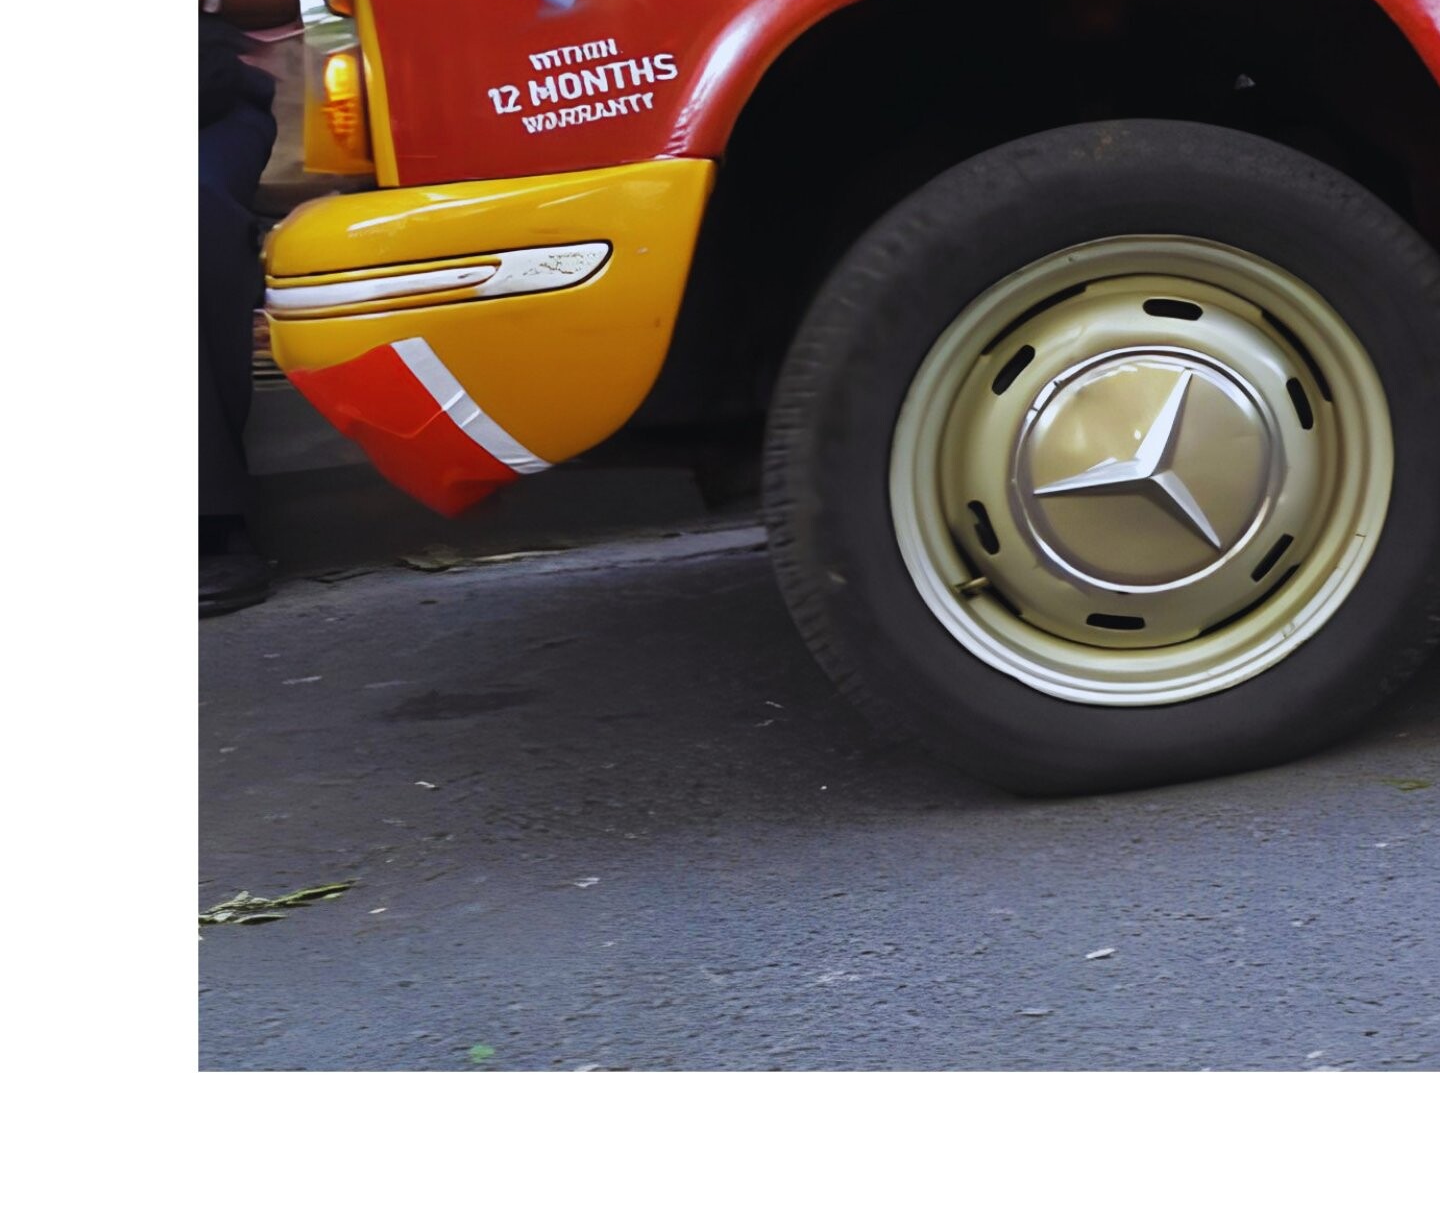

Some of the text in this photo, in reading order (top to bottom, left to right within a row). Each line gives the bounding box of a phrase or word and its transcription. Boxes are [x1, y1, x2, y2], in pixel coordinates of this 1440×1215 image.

[487, 53, 678, 114] 12 MONTHS
[522, 92, 653, 133] WARRANTY
